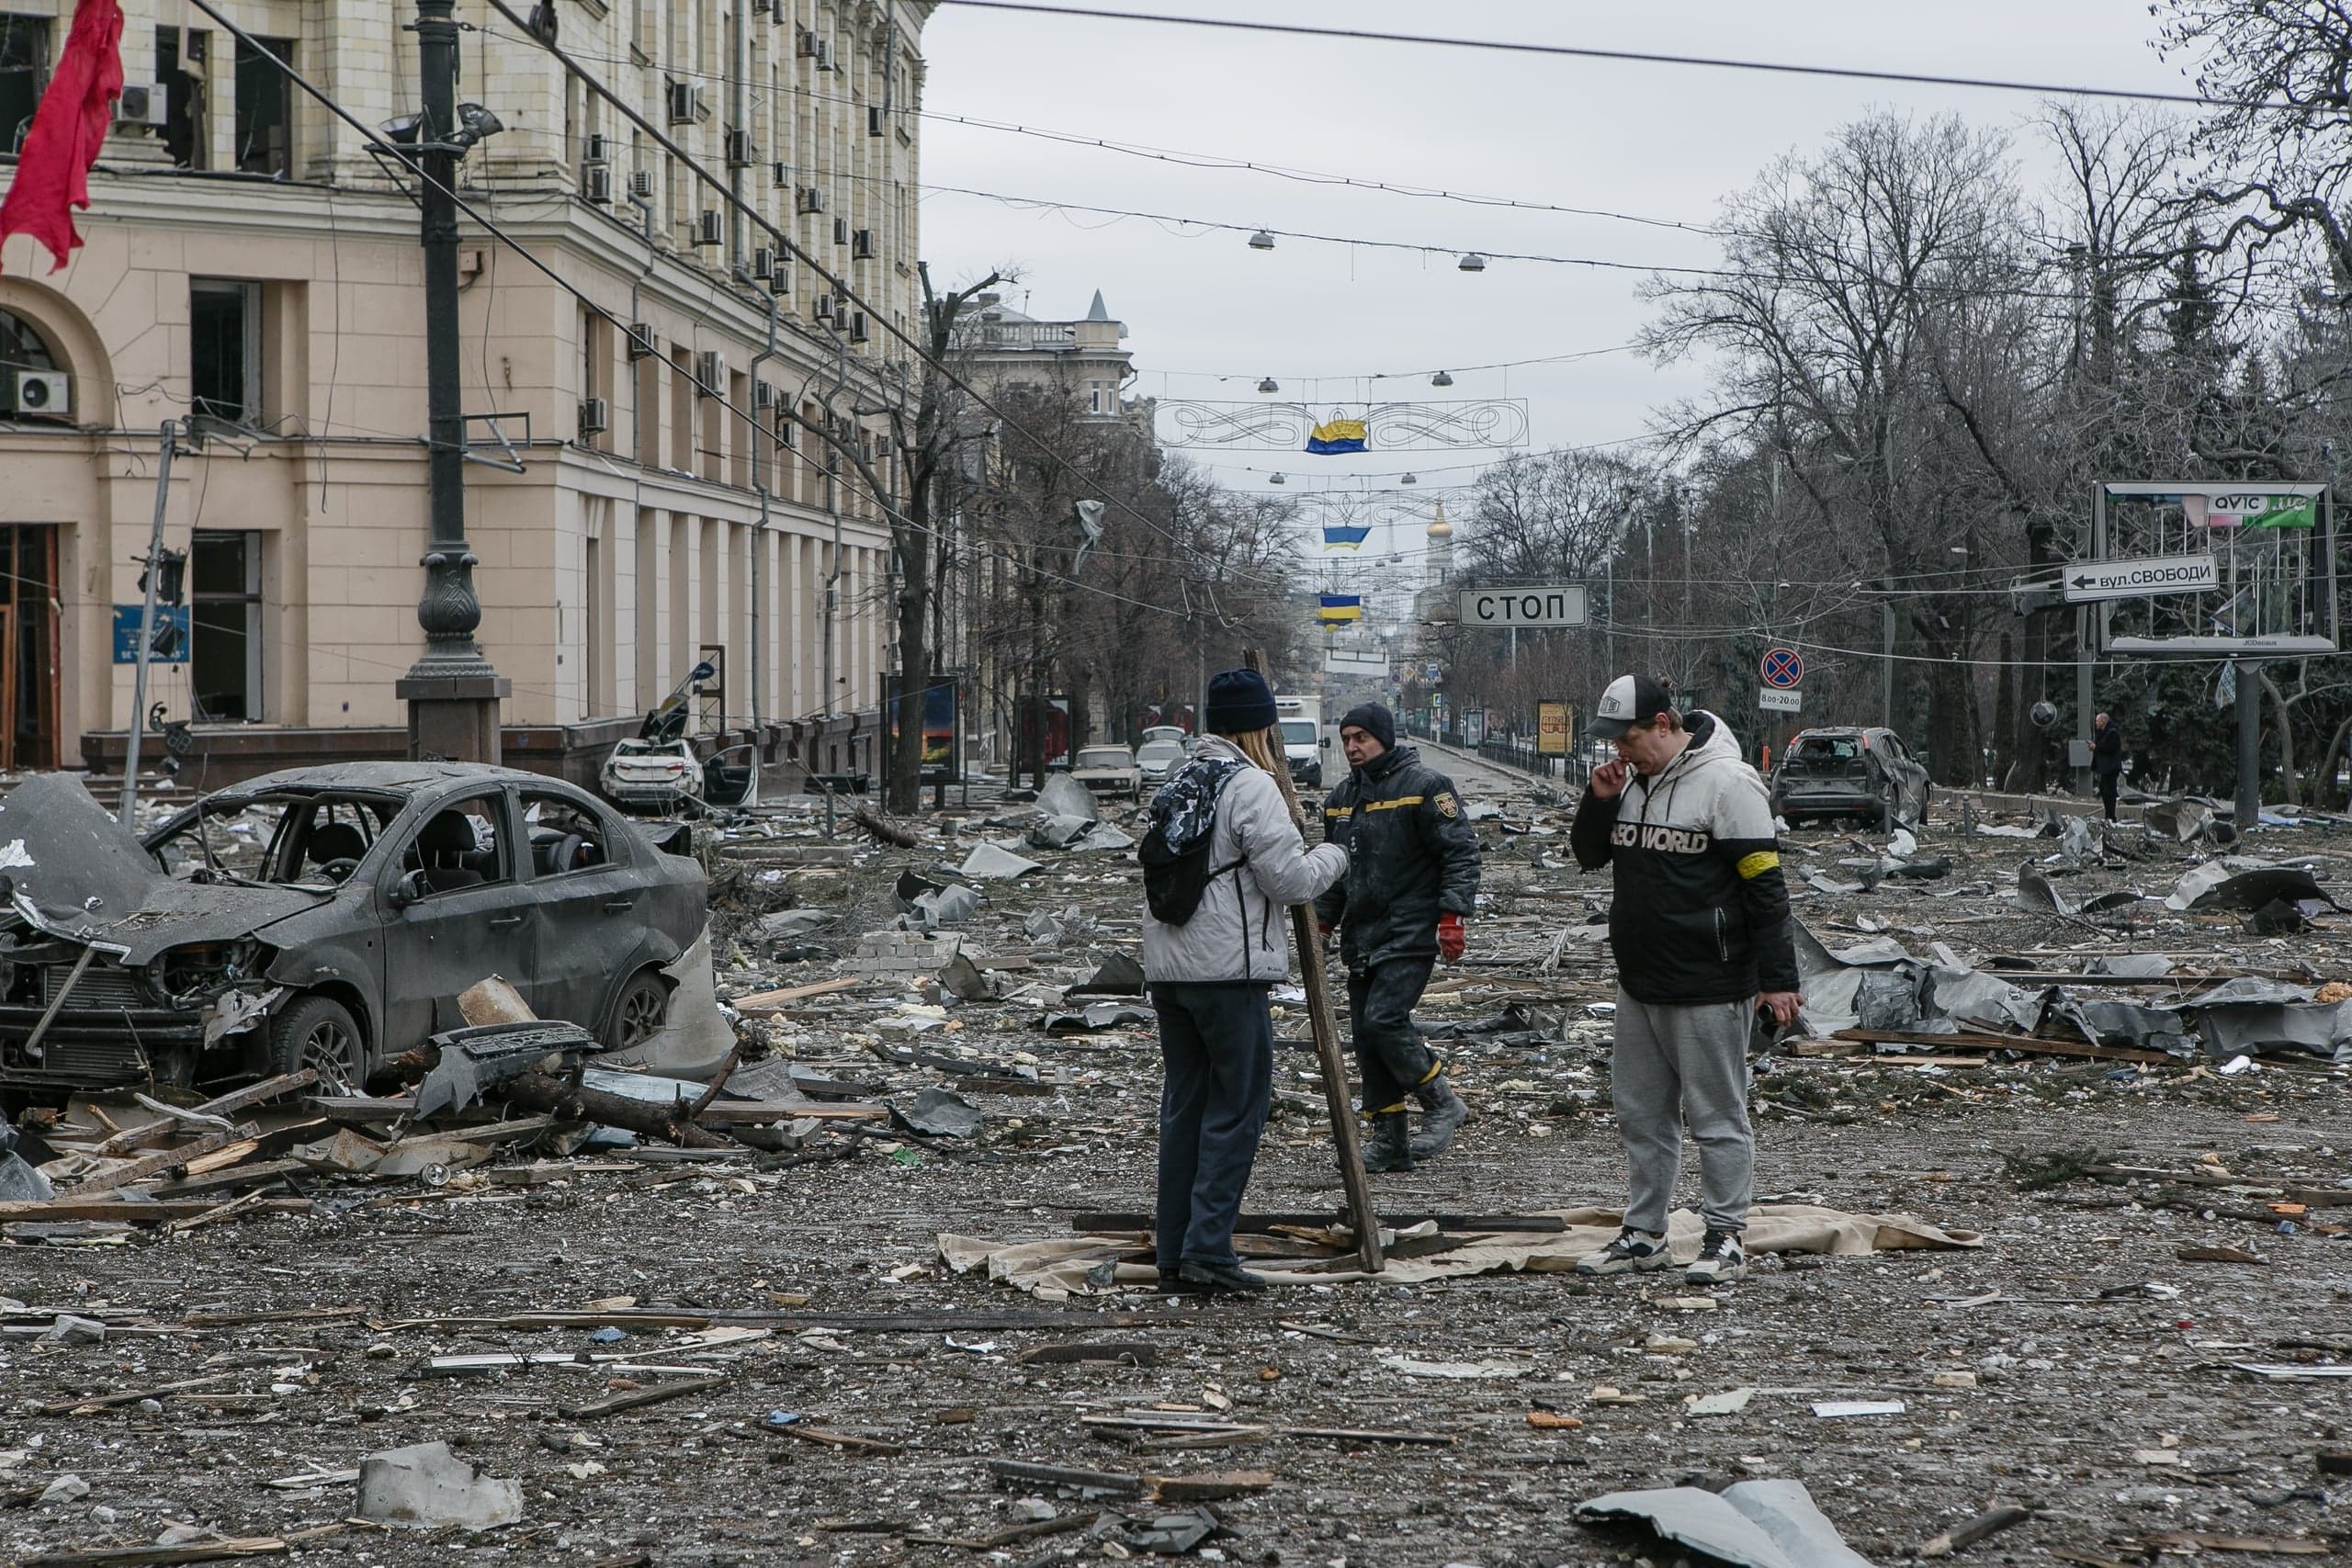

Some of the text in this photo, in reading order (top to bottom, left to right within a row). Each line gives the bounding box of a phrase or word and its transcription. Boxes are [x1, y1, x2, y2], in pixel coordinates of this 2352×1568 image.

[2100, 565, 2211, 589] вул.СВОБОДИ
[1476, 594, 1565, 621] СТОП
[1641, 825, 1709, 854] WORLD
